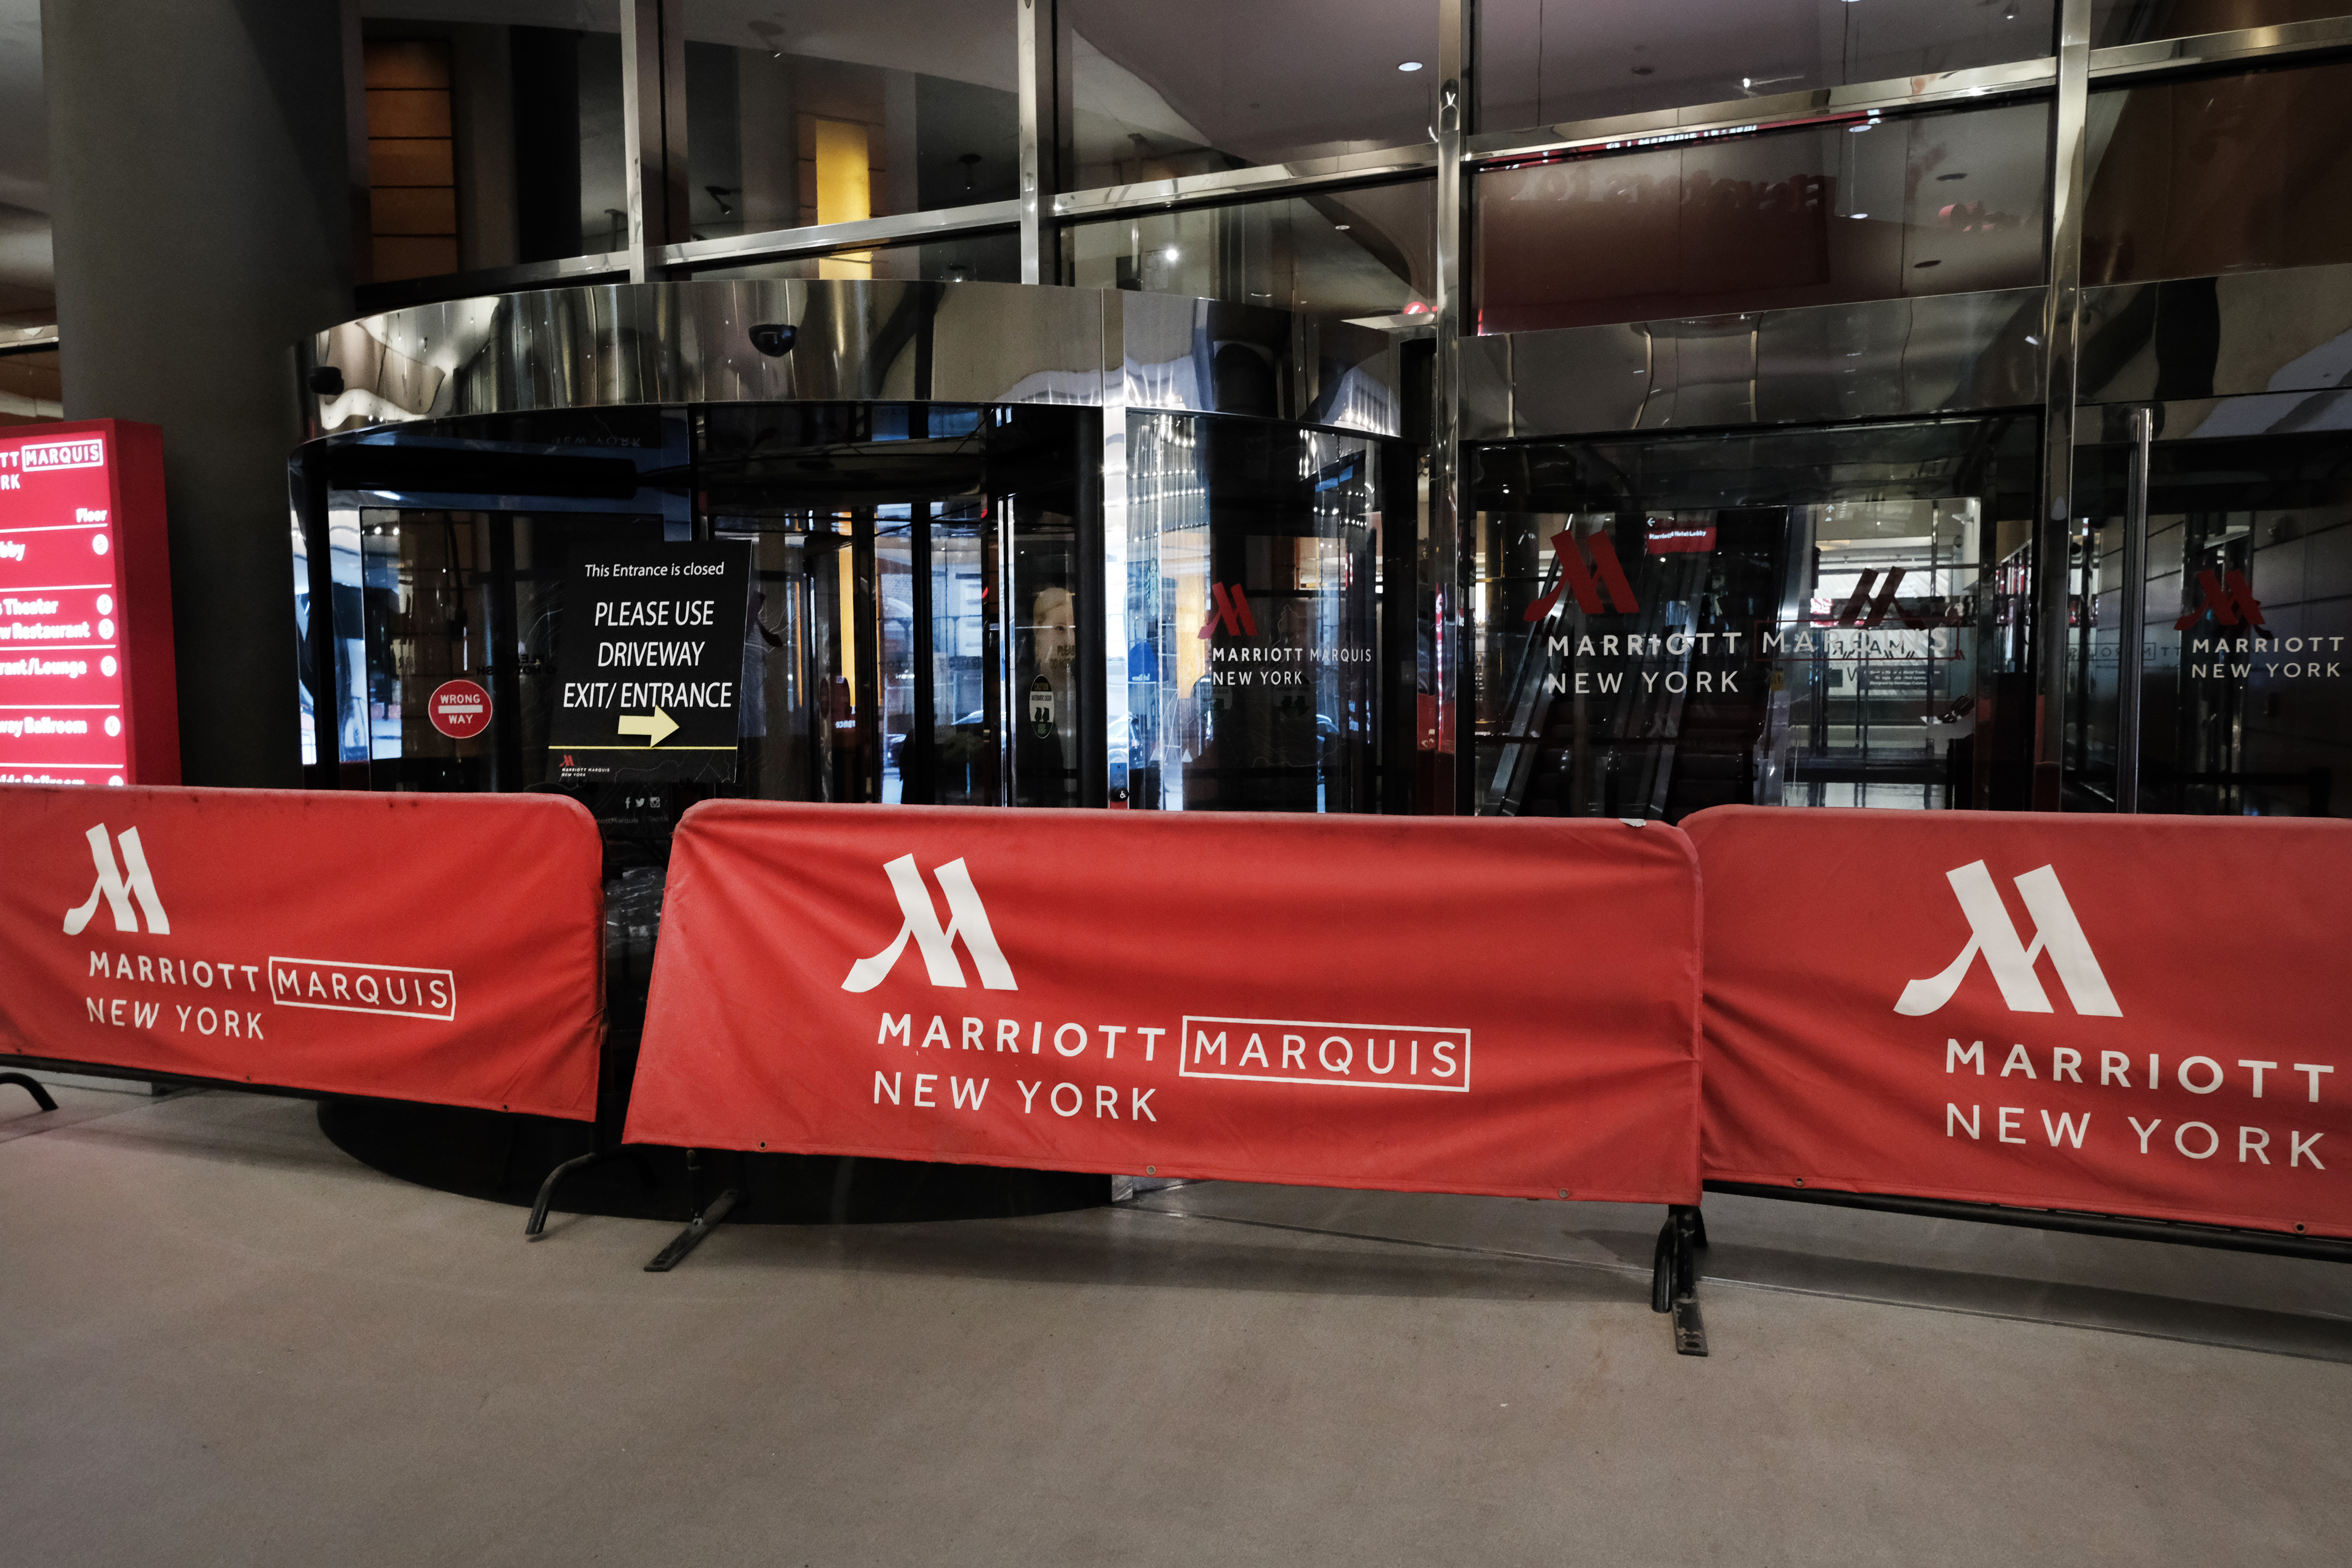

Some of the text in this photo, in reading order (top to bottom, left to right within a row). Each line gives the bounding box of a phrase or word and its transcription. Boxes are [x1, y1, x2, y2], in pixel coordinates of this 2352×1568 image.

[25, 445, 99, 466] MARQUIS
[76, 507, 108, 523] Floor
[585, 561, 725, 577] This Entrance is closed
[5, 598, 59, 616] Theater
[595, 600, 714, 626] PLEASE USE
[12, 621, 91, 640] Restaurant
[1548, 631, 1743, 658] MARRIOTT
[1762, 626, 1948, 655] MARQUIS
[2192, 636, 2345, 654] MARRIOTT
[597, 641, 706, 667] DRIVEWAY
[1213, 647, 1373, 664] MARRIOTT MARQUIS
[1213, 670, 1303, 686] NEW YORK
[2191, 662, 2341, 679] NEW YORK
[1548, 670, 1740, 695] NEW YORK
[440, 694, 480, 705] WRONG
[621, 681, 733, 709] ENTRANCE
[24, 717, 88, 734] Ballroom
[448, 714, 474, 725] WAY
[89, 951, 448, 1009] MARRIOTT MARQUIS
[85, 997, 264, 1041] NEW YORK
[877, 1012, 1457, 1078] MARRIOTT MARQUIS
[1945, 1038, 2335, 1104] MARRIOTT
[873, 1070, 1157, 1122] NEW YORK
[1946, 1102, 2326, 1170] NEW YORK
